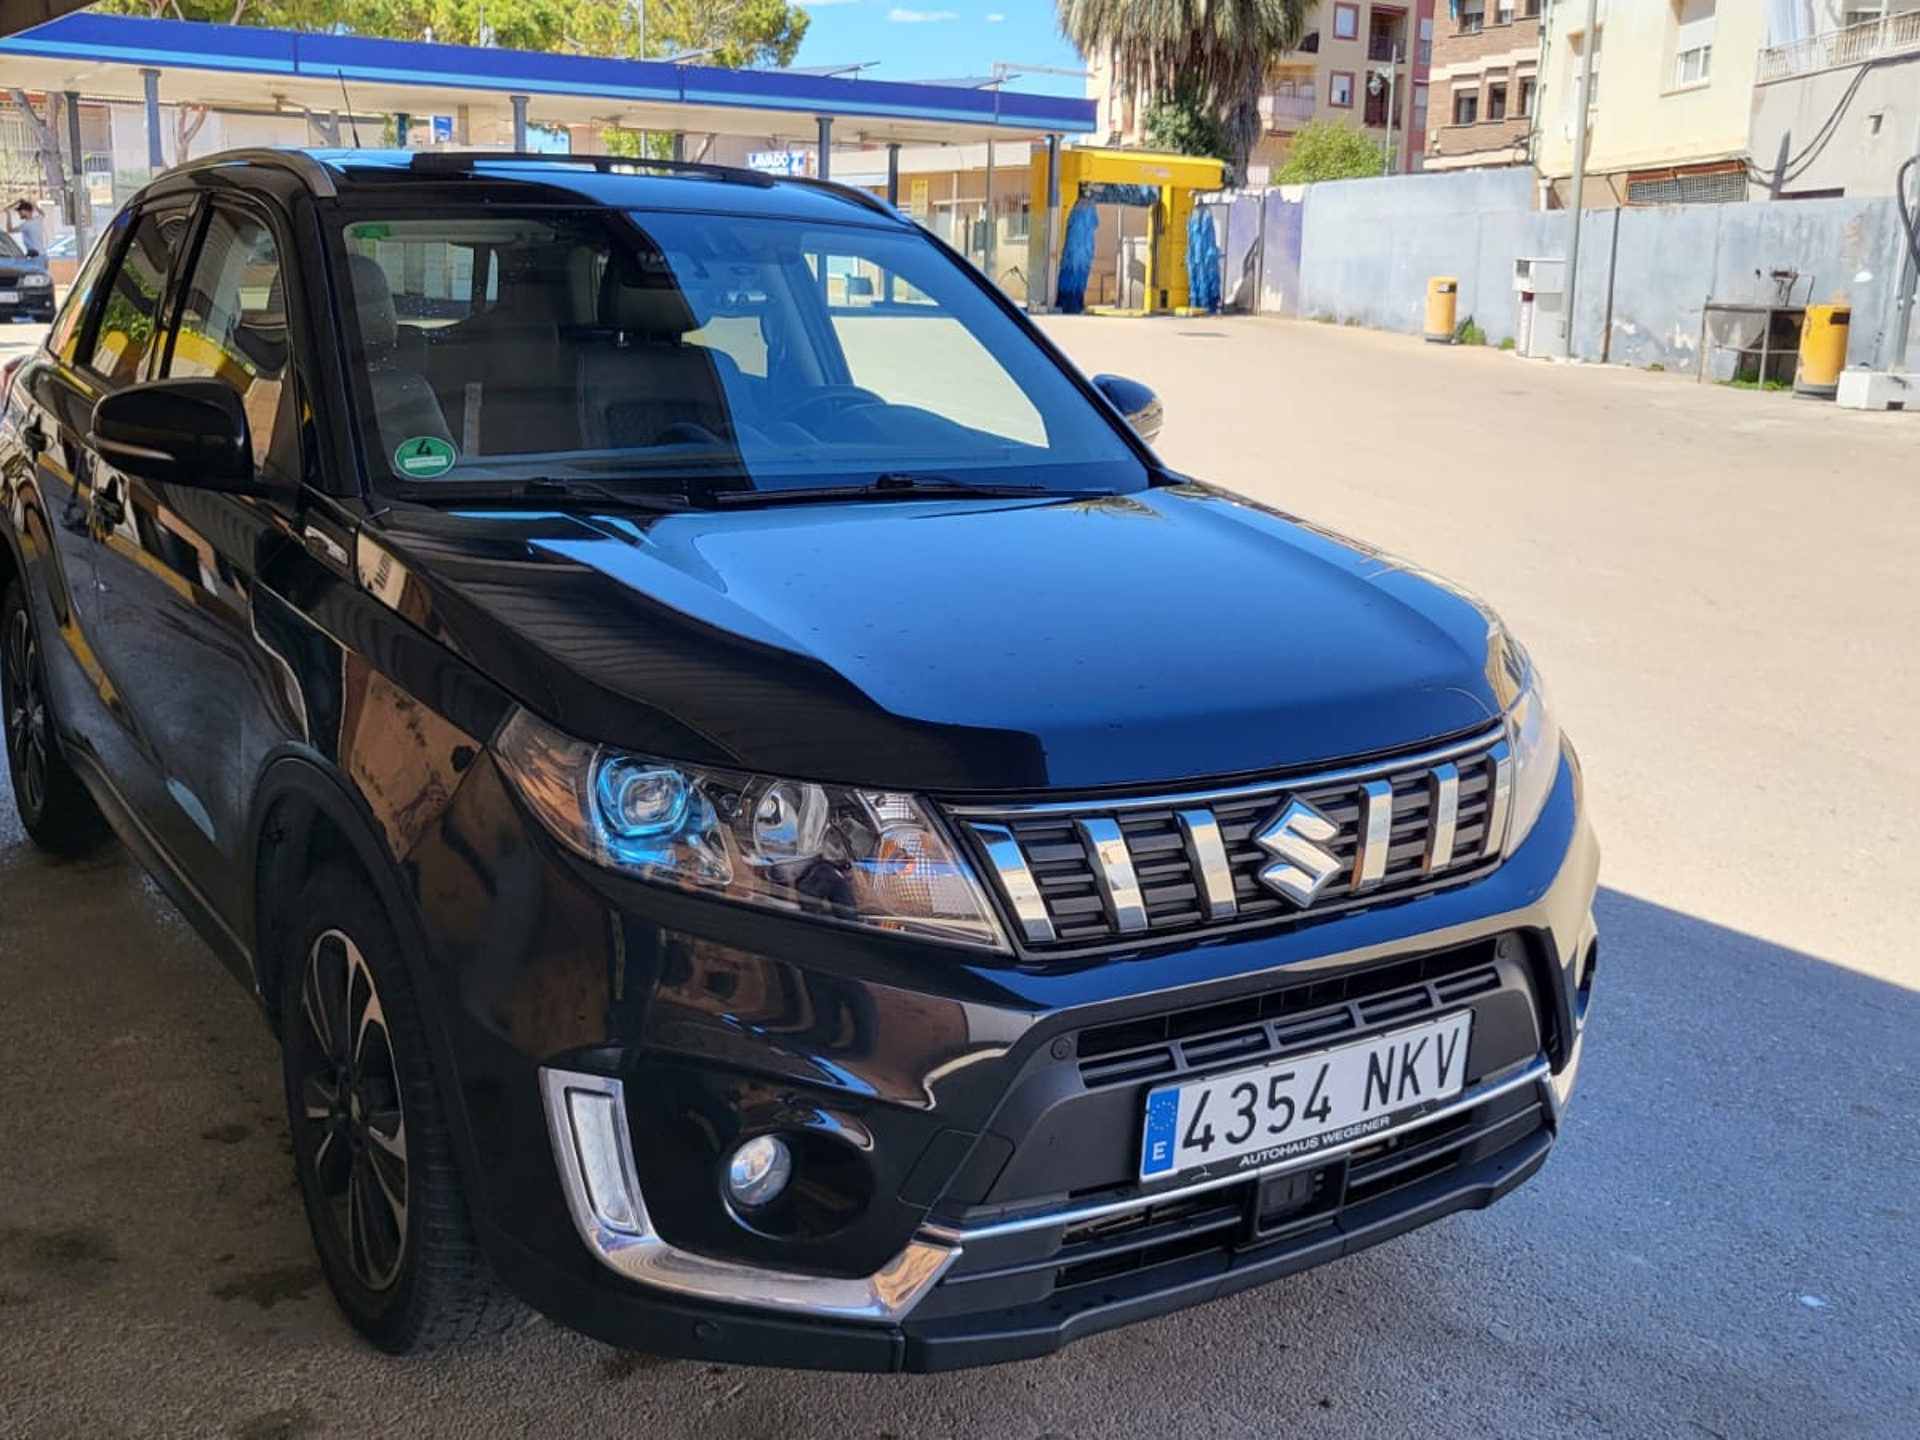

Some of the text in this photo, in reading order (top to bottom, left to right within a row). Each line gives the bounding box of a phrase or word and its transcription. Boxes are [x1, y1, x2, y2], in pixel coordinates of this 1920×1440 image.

[748, 153, 789, 168] LAVADO
[416, 440, 432, 456] 4
[1152, 1028, 1459, 1161] E 4354 NKV
[1239, 1117, 1390, 1167] AUTOHAUS WEGENER
